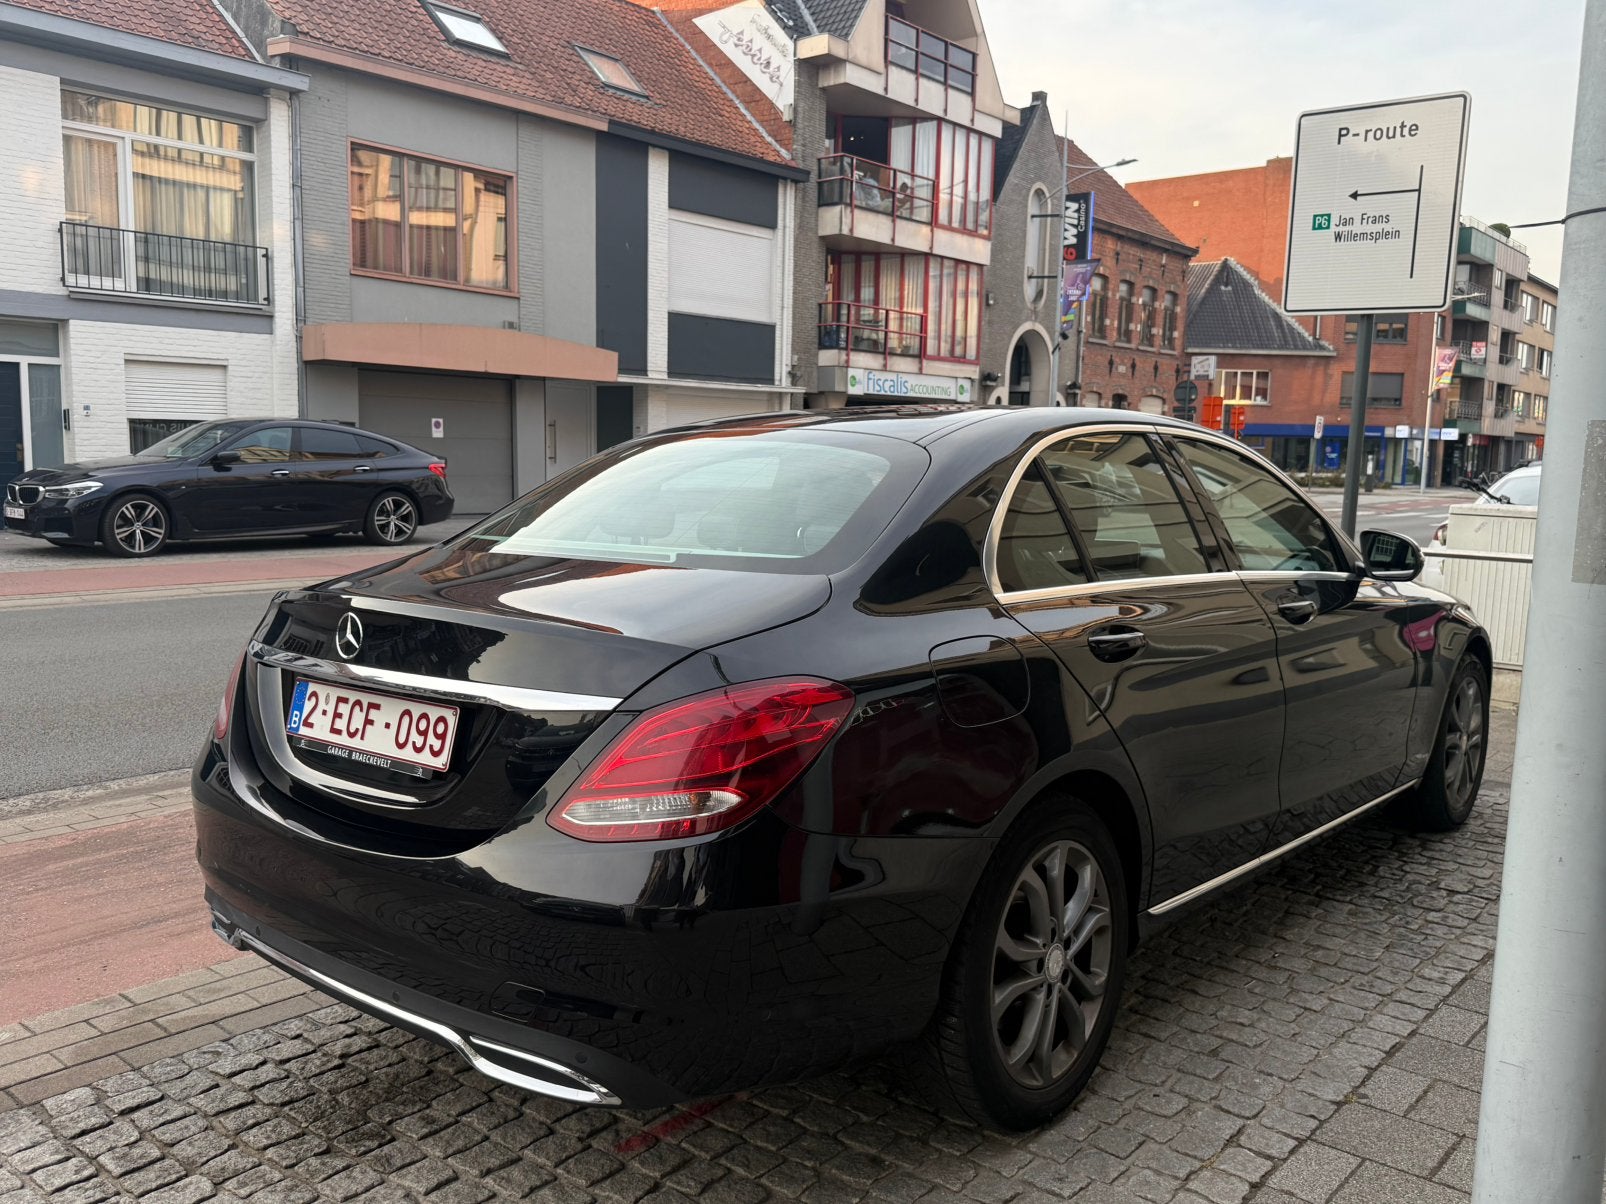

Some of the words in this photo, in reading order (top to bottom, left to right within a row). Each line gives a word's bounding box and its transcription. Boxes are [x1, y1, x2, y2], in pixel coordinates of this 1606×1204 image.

[1338, 121, 1419, 144] P-route
[1315, 216, 1328, 227] P6
[1335, 214, 1354, 227] Jan
[1360, 212, 1390, 225] Frans
[1334, 228, 1400, 243] Willemsplein
[867, 371, 909, 394] fiscalis
[910, 384, 952, 396] ACCOUNTING
[290, 711, 300, 728] B
[327, 745, 350, 758] GARAGE
[352, 752, 392, 768] BRAECKEVELT
